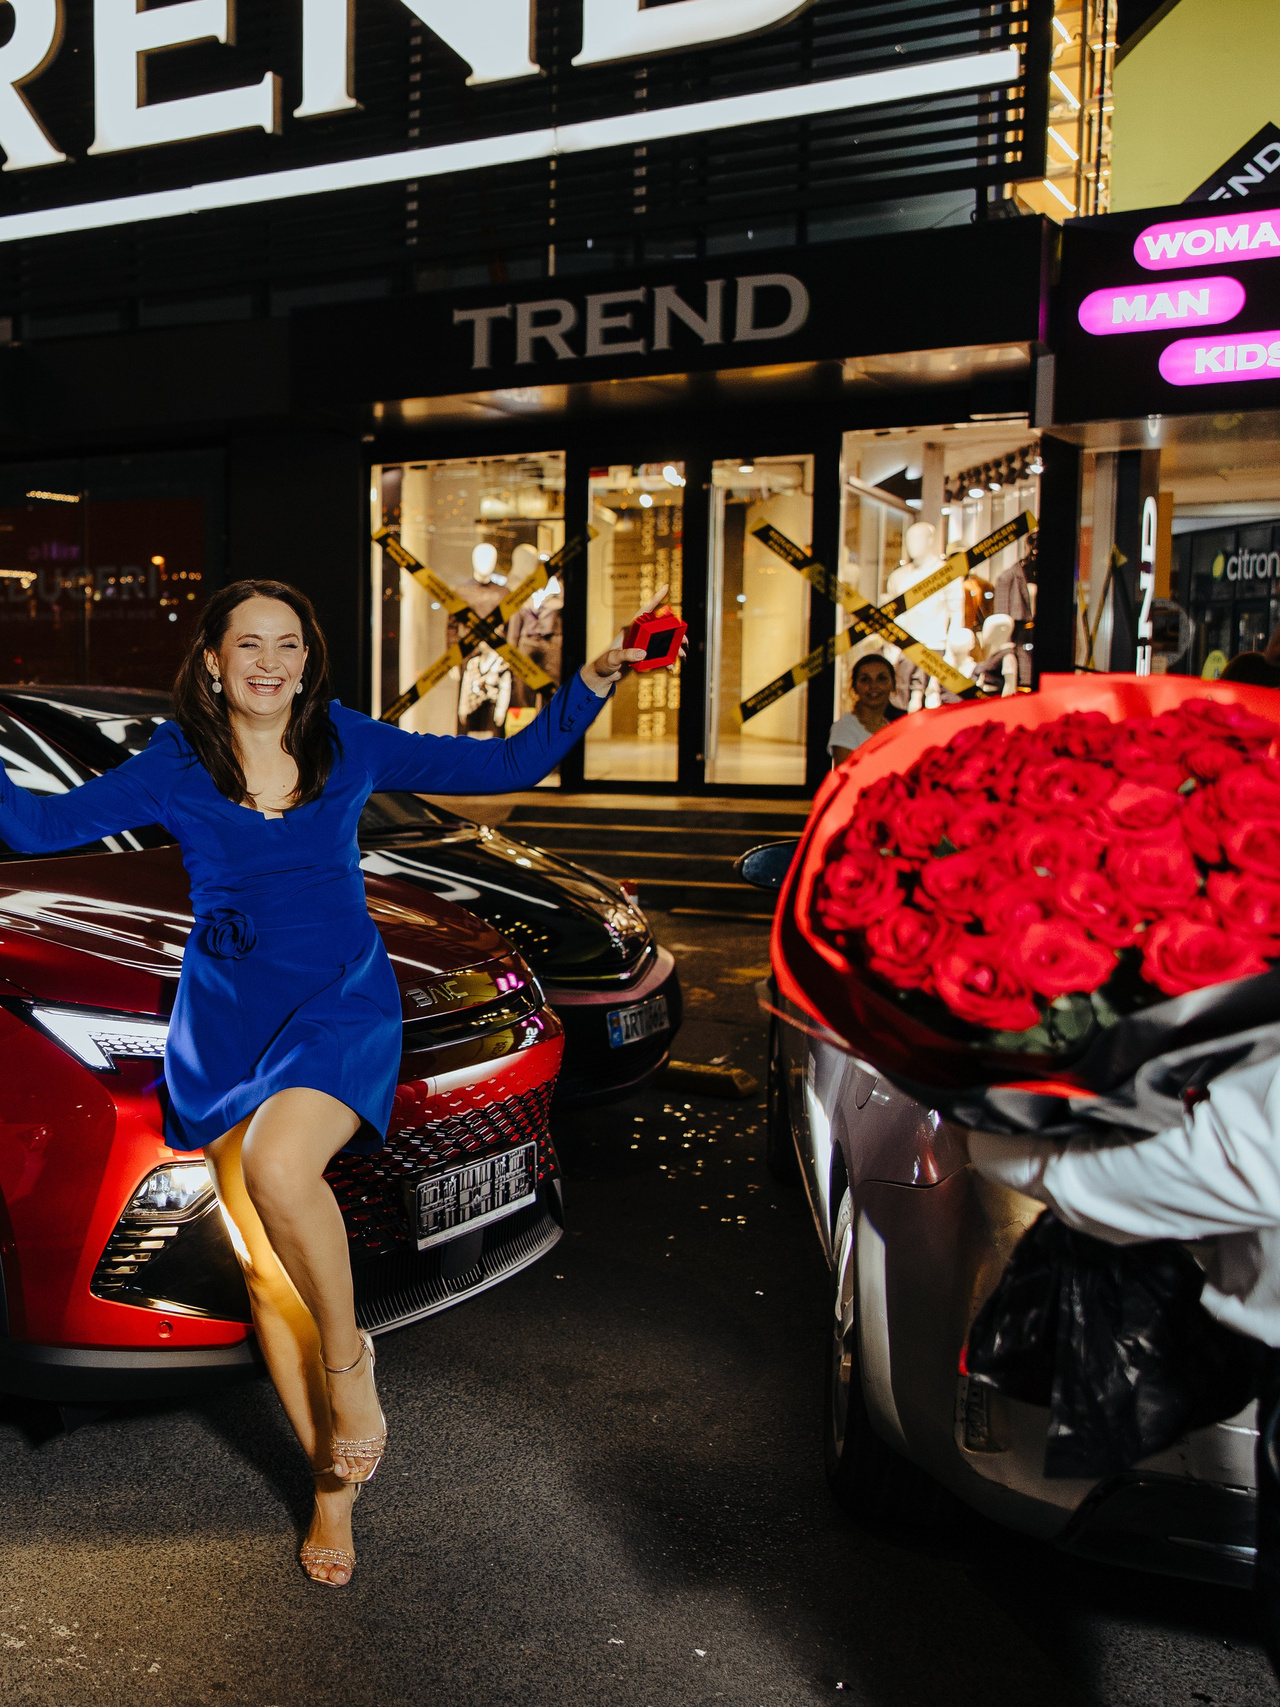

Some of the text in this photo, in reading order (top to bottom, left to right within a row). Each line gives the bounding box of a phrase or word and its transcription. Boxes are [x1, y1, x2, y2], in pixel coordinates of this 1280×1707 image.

[453, 271, 811, 371] TREND
[1112, 288, 1210, 324] MAN
[1194, 341, 1280, 374] KIDS
[972, 521, 1018, 556] REDUCERI
[1227, 547, 1280, 581] citron
